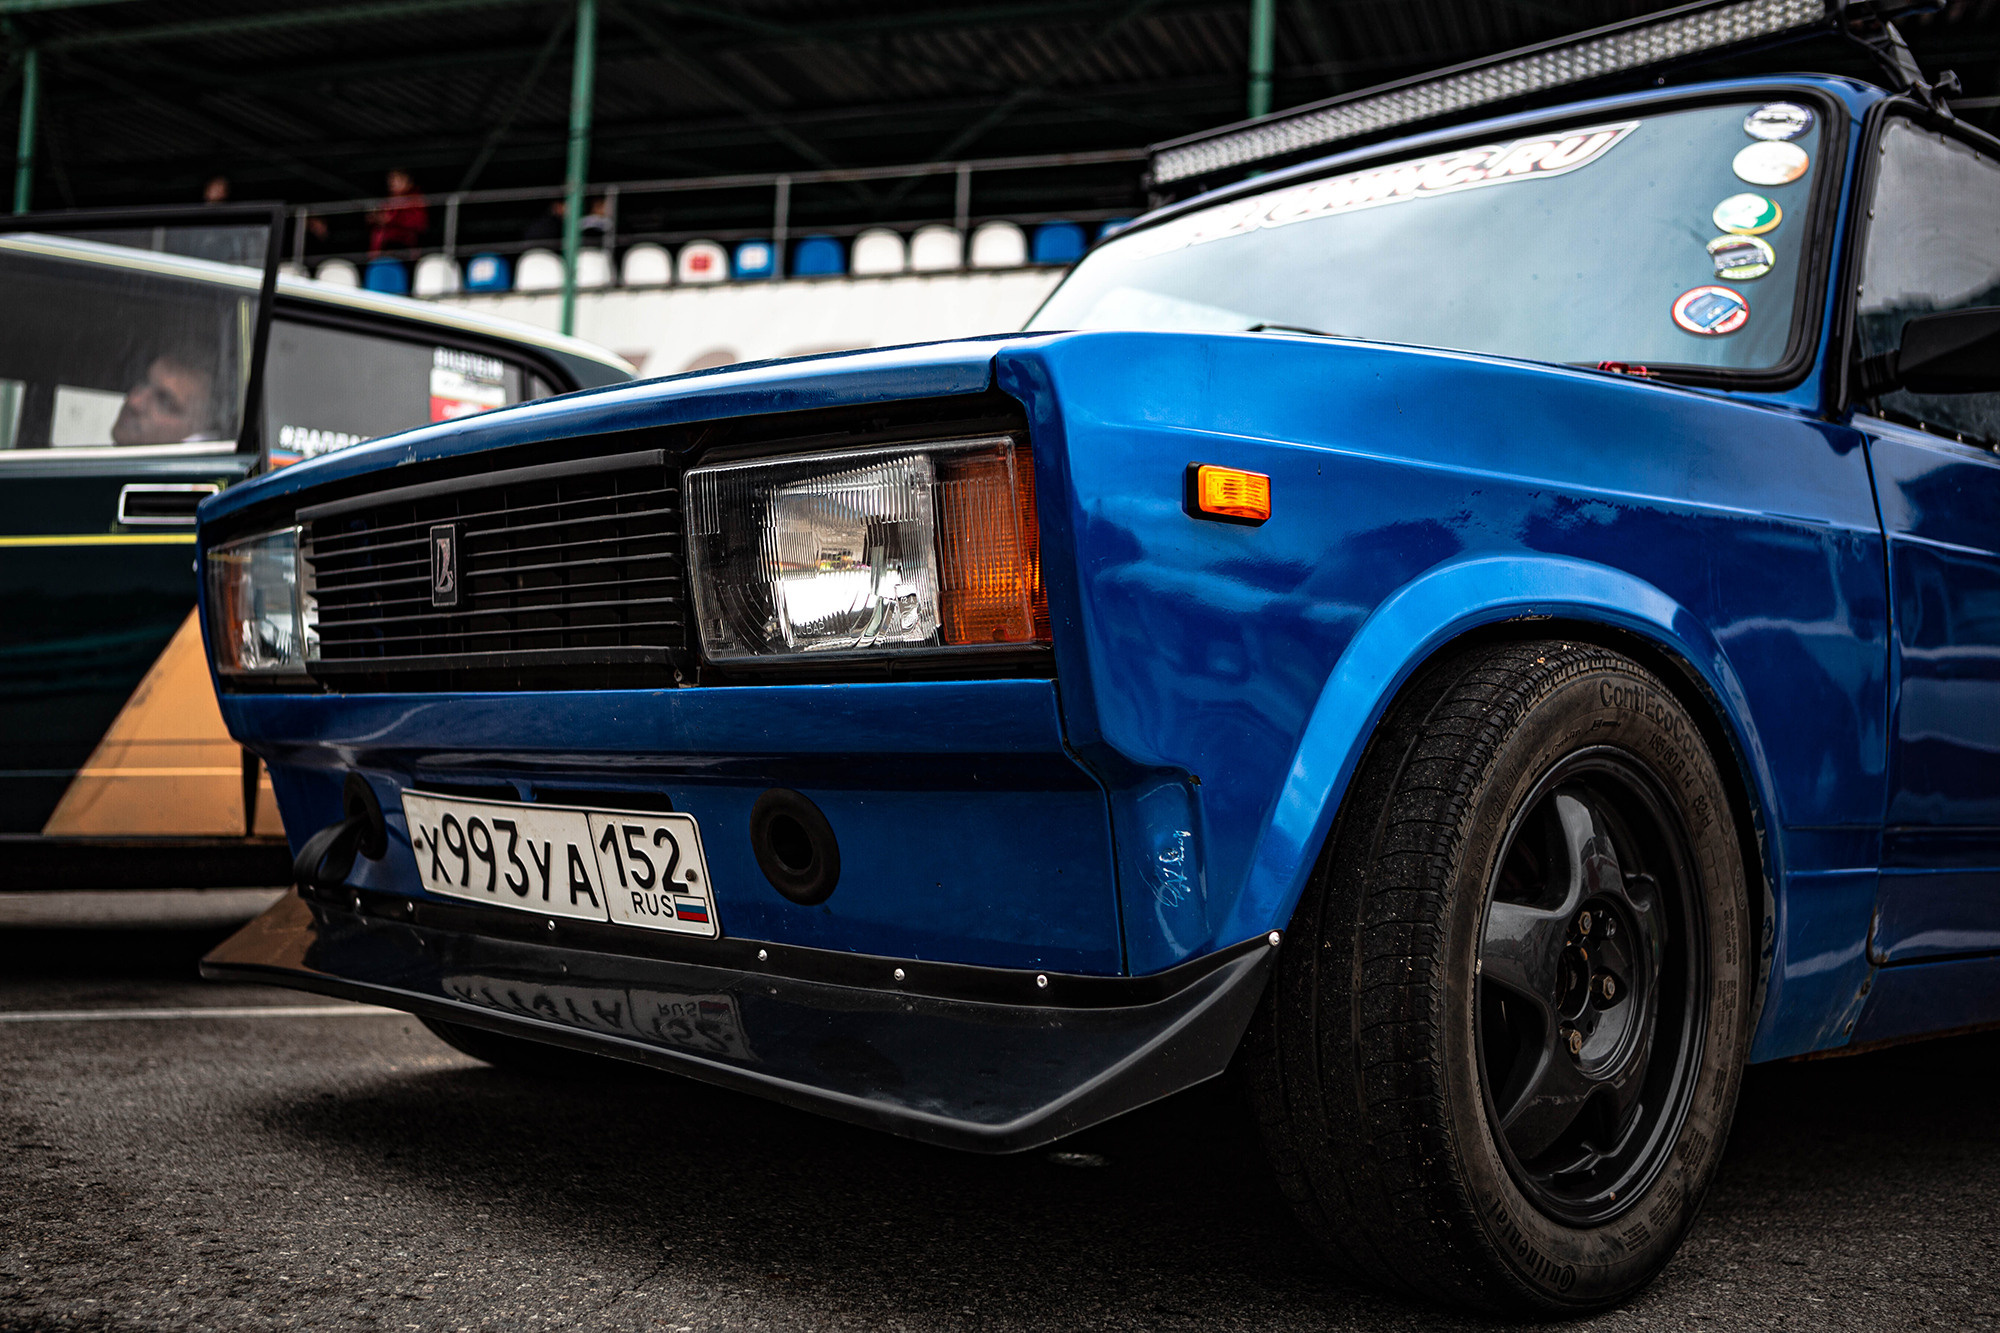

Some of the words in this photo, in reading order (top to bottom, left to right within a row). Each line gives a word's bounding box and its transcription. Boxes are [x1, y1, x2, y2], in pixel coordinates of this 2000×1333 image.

[420, 813, 599, 908] Х993УА
[600, 823, 690, 894] 152
[631, 891, 675, 918] RUS
